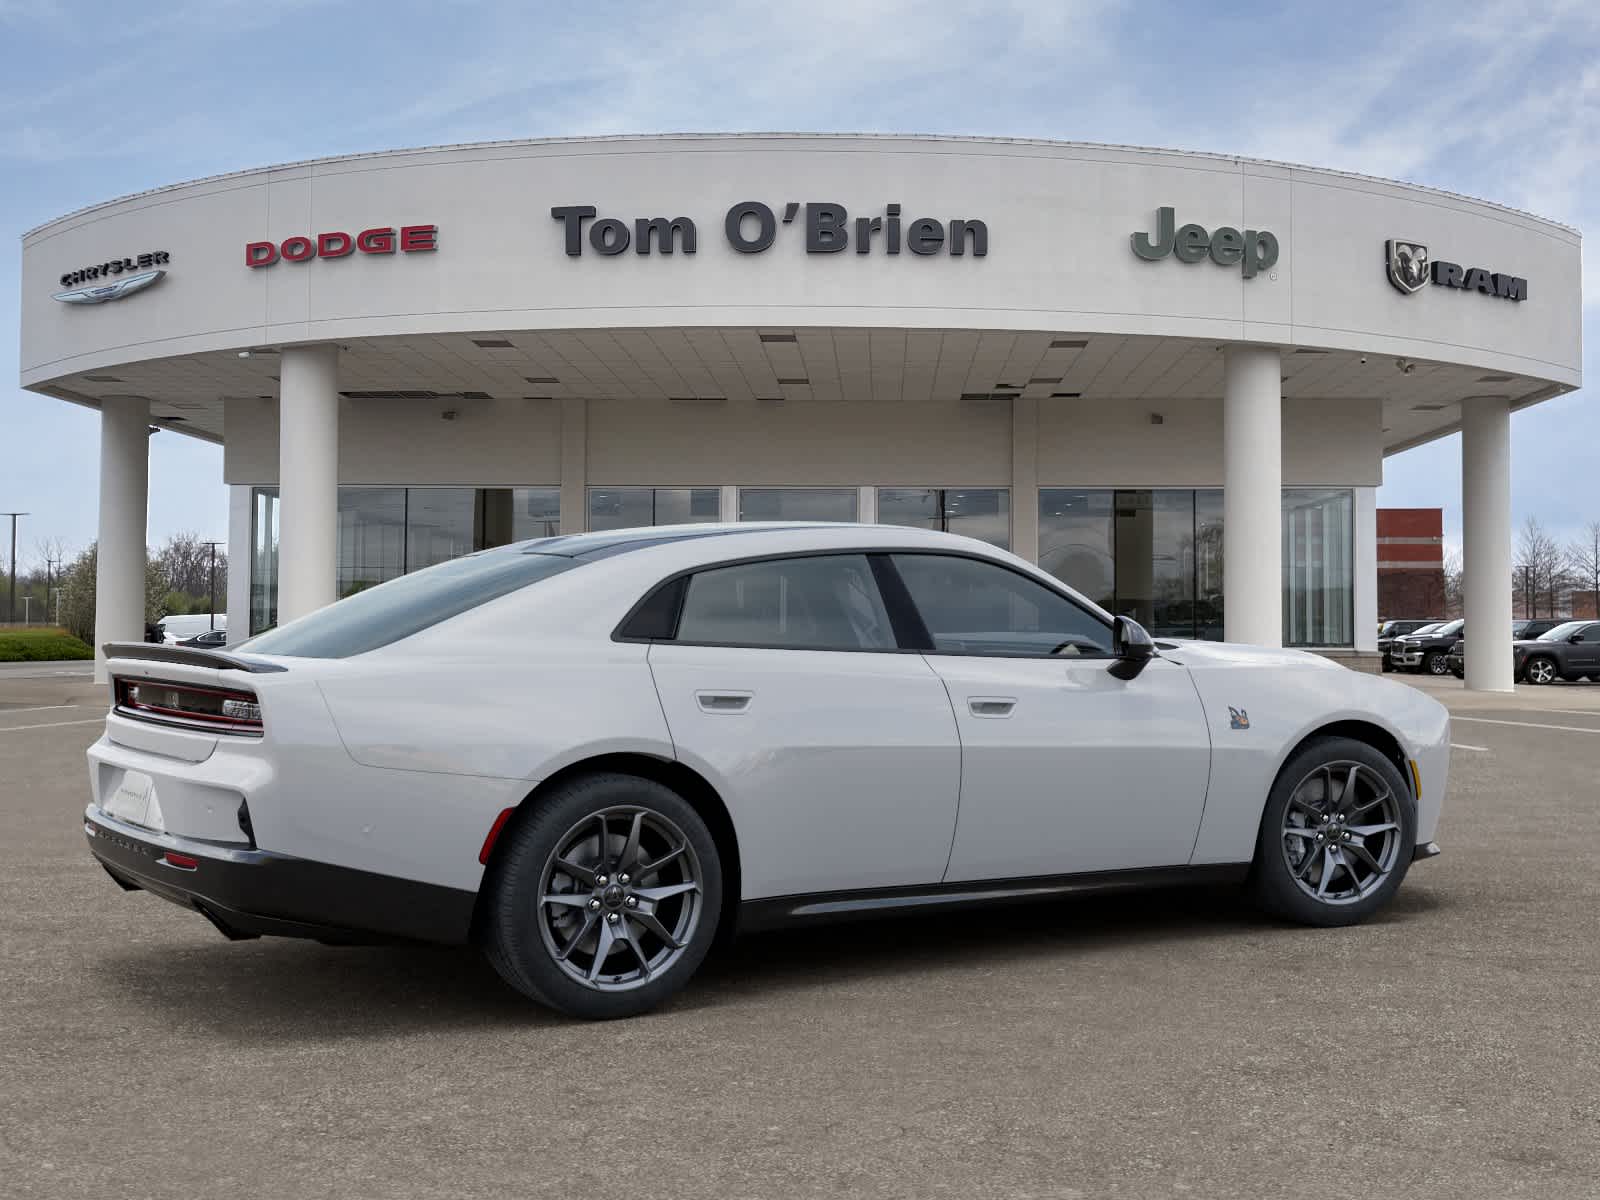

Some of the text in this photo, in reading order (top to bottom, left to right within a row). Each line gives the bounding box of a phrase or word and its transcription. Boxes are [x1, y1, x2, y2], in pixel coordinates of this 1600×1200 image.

[245, 224, 438, 269] DODGE
[551, 201, 989, 257] Tom O'Brien
[1130, 206, 1280, 279] Jeep
[60, 250, 170, 287] CHRYSLER
[1431, 260, 1528, 301] RAM
